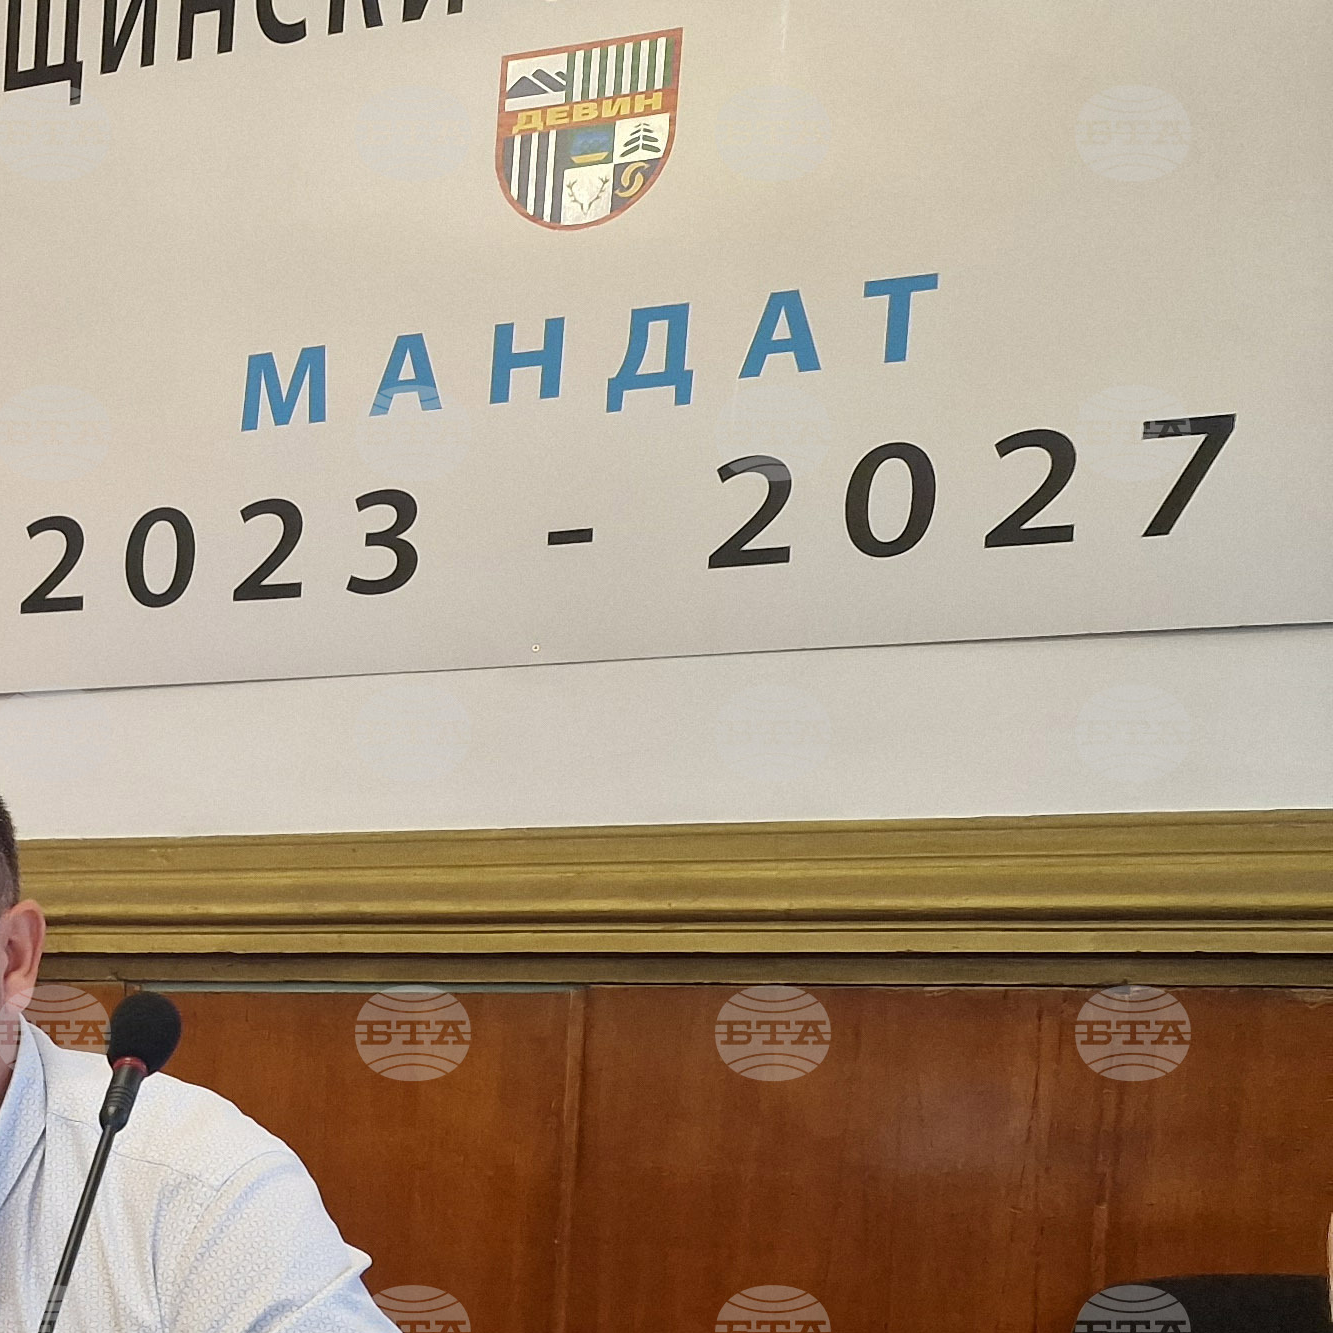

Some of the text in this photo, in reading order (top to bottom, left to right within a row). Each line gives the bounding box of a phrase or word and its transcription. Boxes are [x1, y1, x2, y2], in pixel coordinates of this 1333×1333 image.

[511, 91, 663, 135] ДЕВИН
[239, 272, 940, 433] МАНДАТ
[19, 412, 1237, 614] 2023 - 2027
